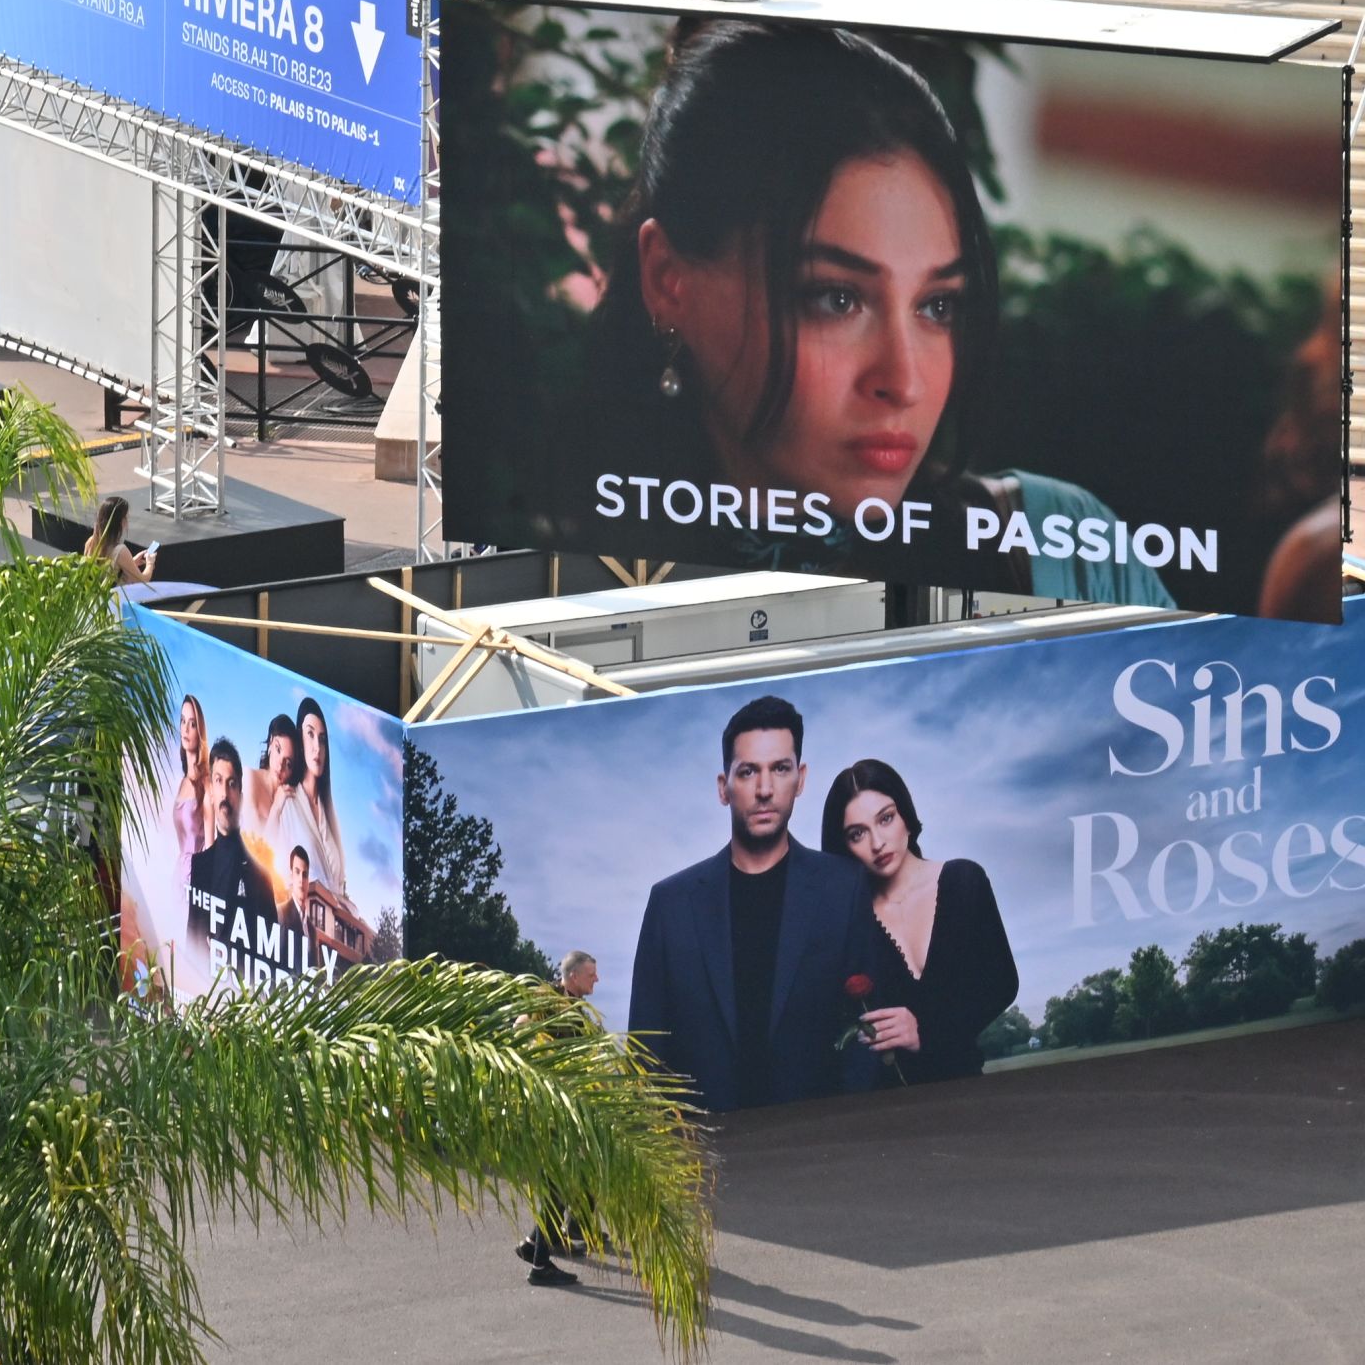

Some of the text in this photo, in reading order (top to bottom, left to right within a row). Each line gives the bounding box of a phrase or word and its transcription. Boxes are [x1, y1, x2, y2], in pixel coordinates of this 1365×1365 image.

[182, 21, 332, 92] STANDS R8.A4 TO R8.E23
[303, 5, 324, 53] 8
[211, 72, 380, 146] ACCESS TO: PALAIS 5 TO PALAIS -1
[595, 472, 1219, 575] STORIES OF PASSION
[1108, 657, 1342, 777] Sins
[1185, 766, 1262, 822] and
[185, 885, 211, 912] THE
[1069, 810, 1365, 930] Roses
[210, 895, 338, 986] FAMILY
